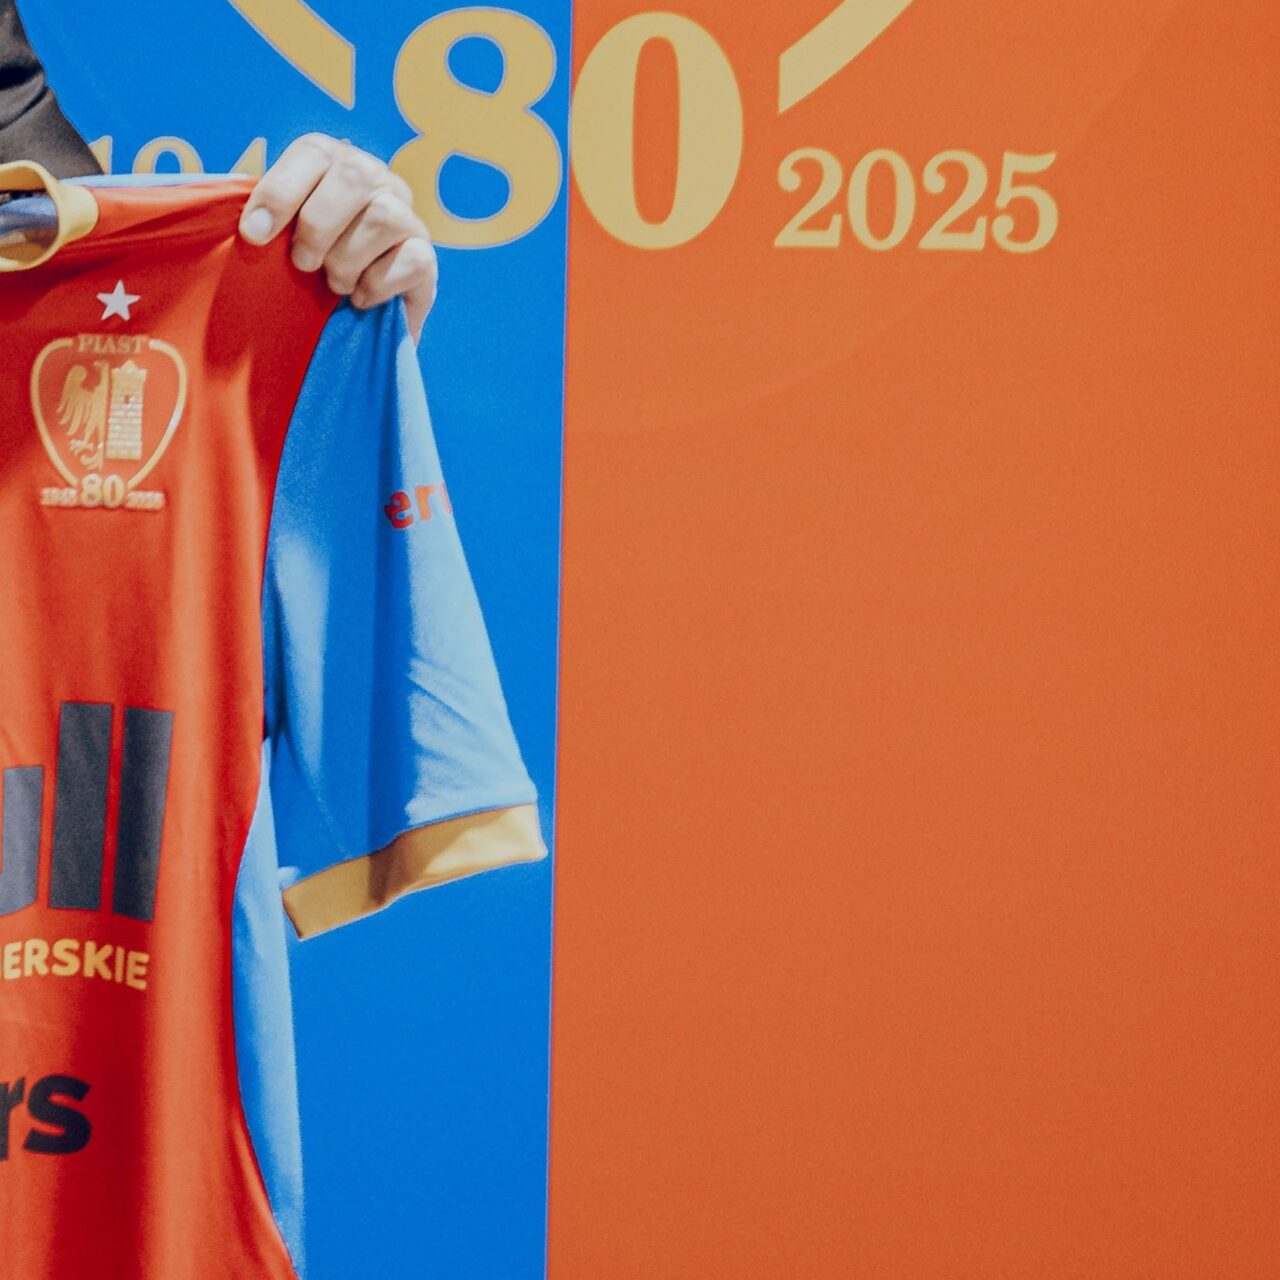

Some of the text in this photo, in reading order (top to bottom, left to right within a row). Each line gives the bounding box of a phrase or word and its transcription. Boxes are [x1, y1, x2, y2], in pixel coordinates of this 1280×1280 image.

[390, 5, 1059, 253] 80 2025
[78, 333, 148, 354] PIAST
[81, 473, 125, 508] 80
